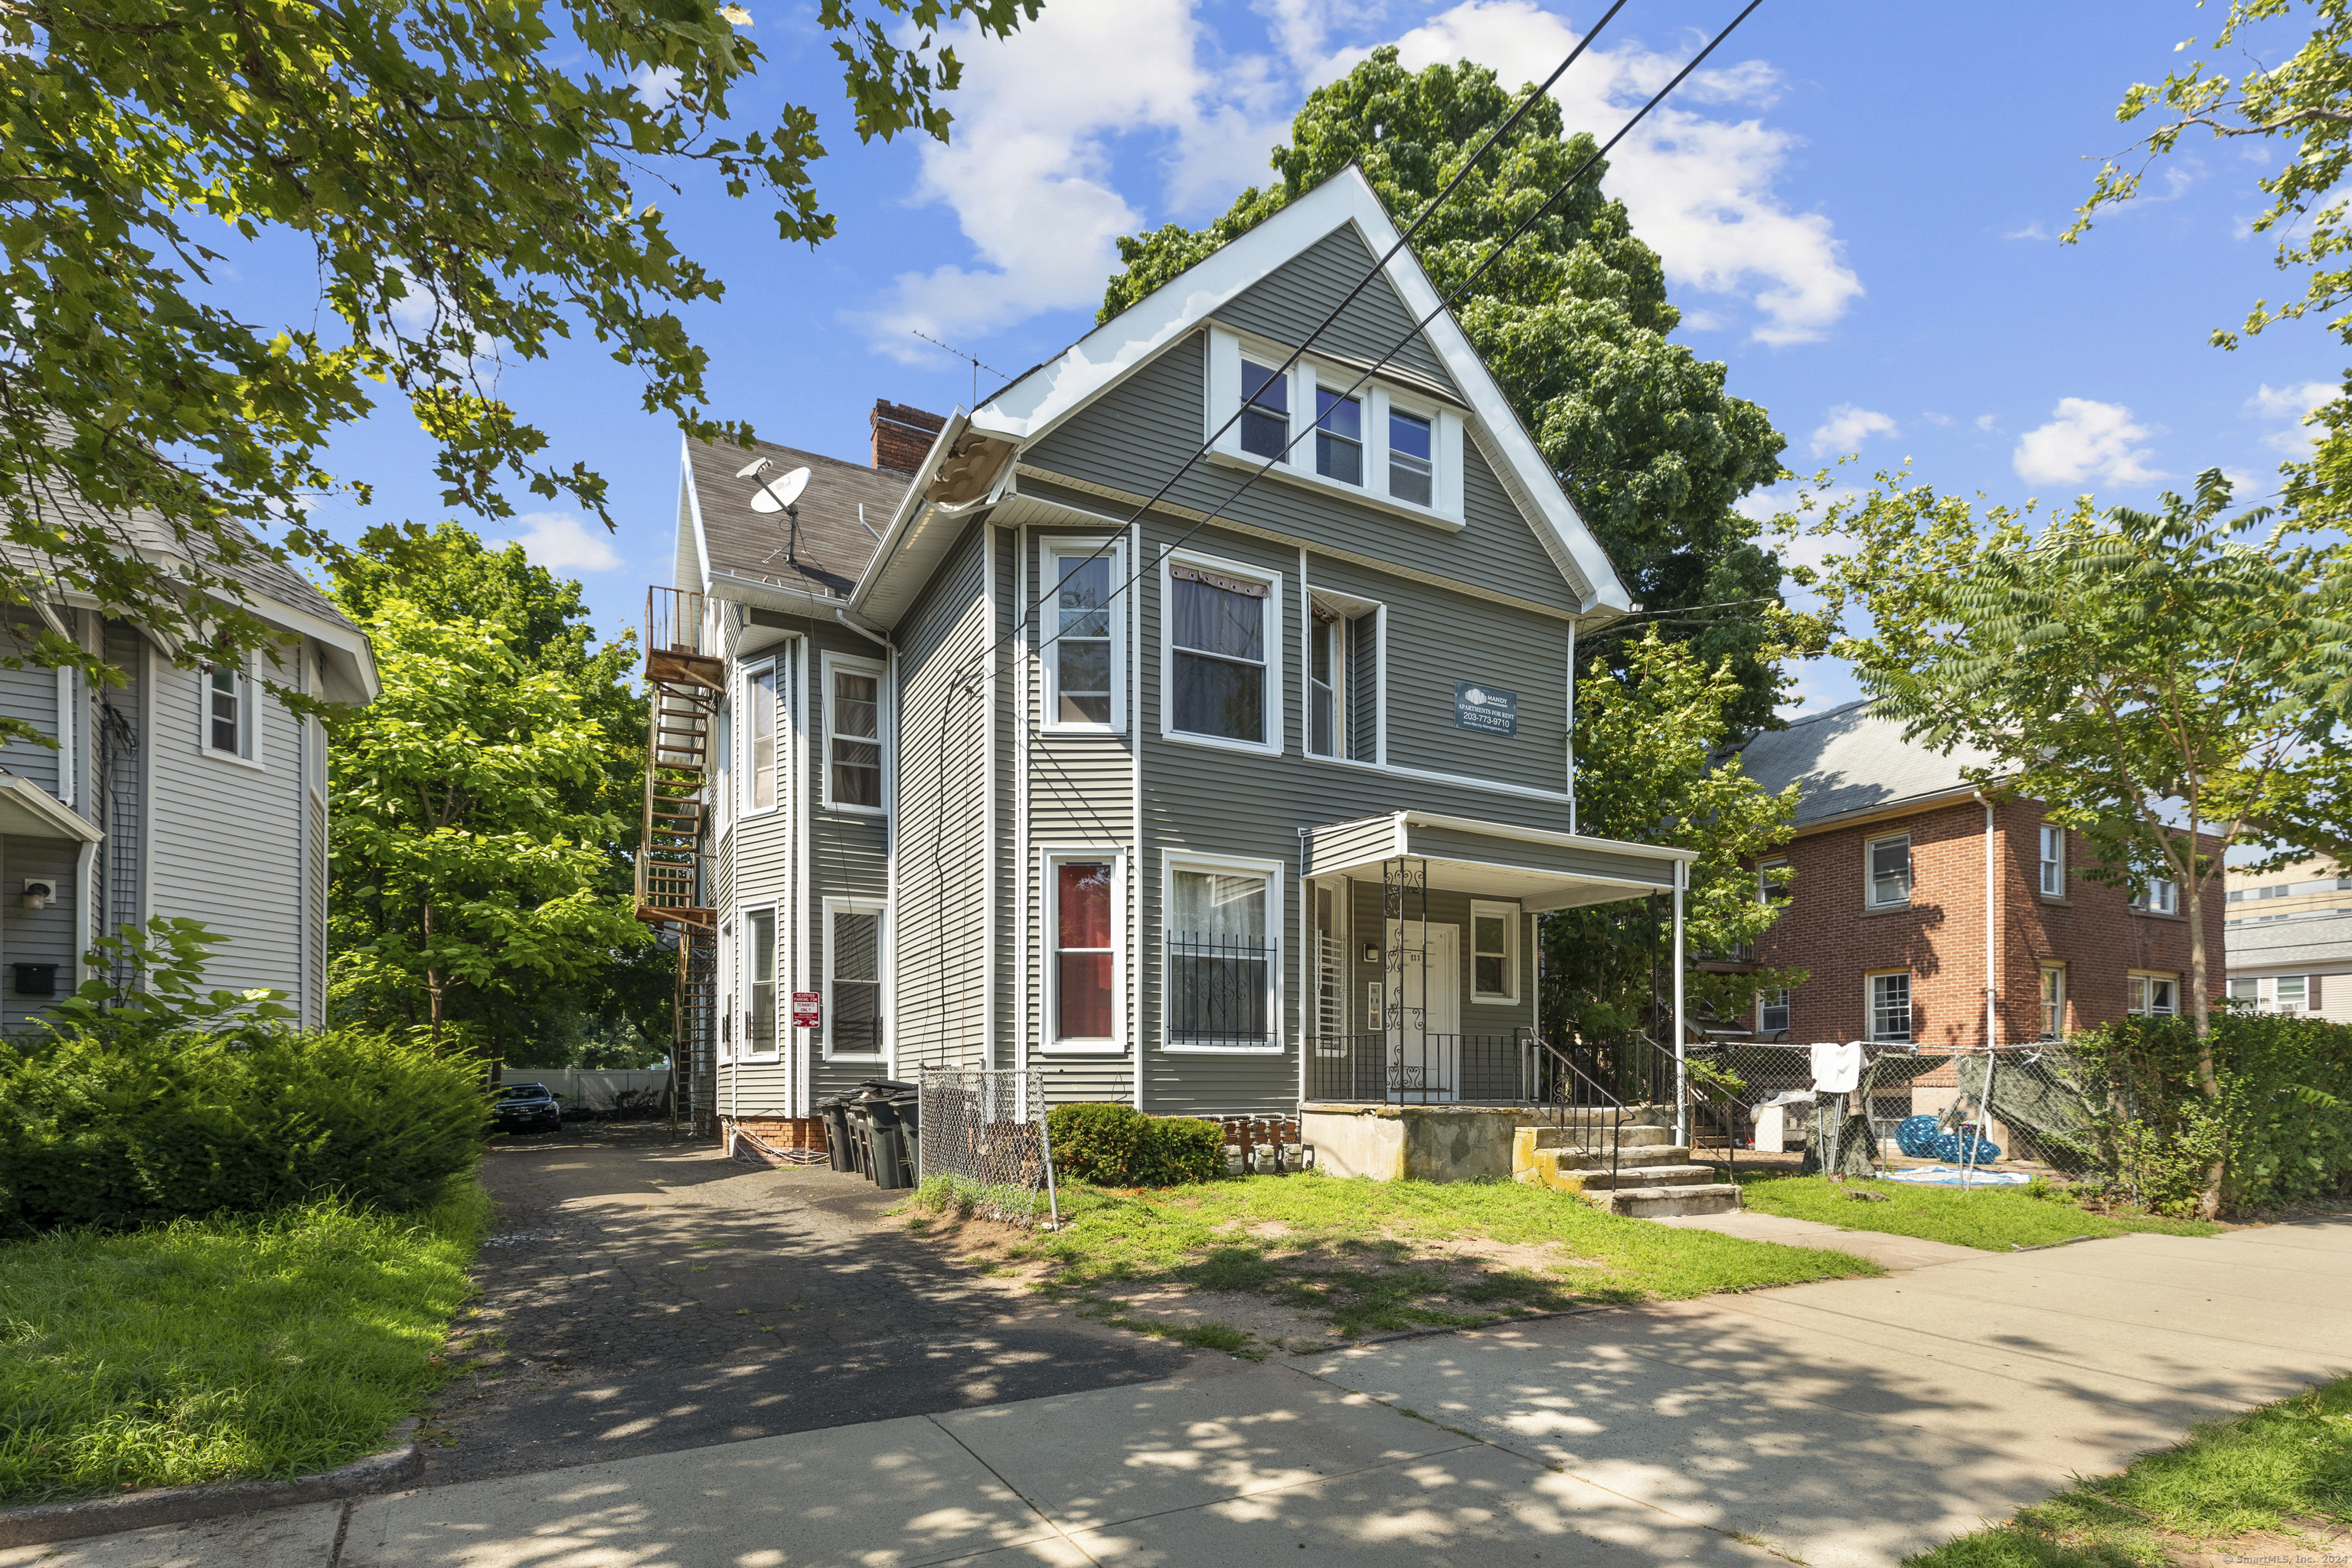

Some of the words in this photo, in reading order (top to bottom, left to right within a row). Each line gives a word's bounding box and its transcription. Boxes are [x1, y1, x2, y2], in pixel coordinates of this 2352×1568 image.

[1488, 695, 1508, 704] MANDY
[1459, 704, 1491, 714] APARTMENTS
[1463, 712, 1509, 727] 203-773-9710
[1463, 720, 1509, 733] www.Mandy-Management.com
